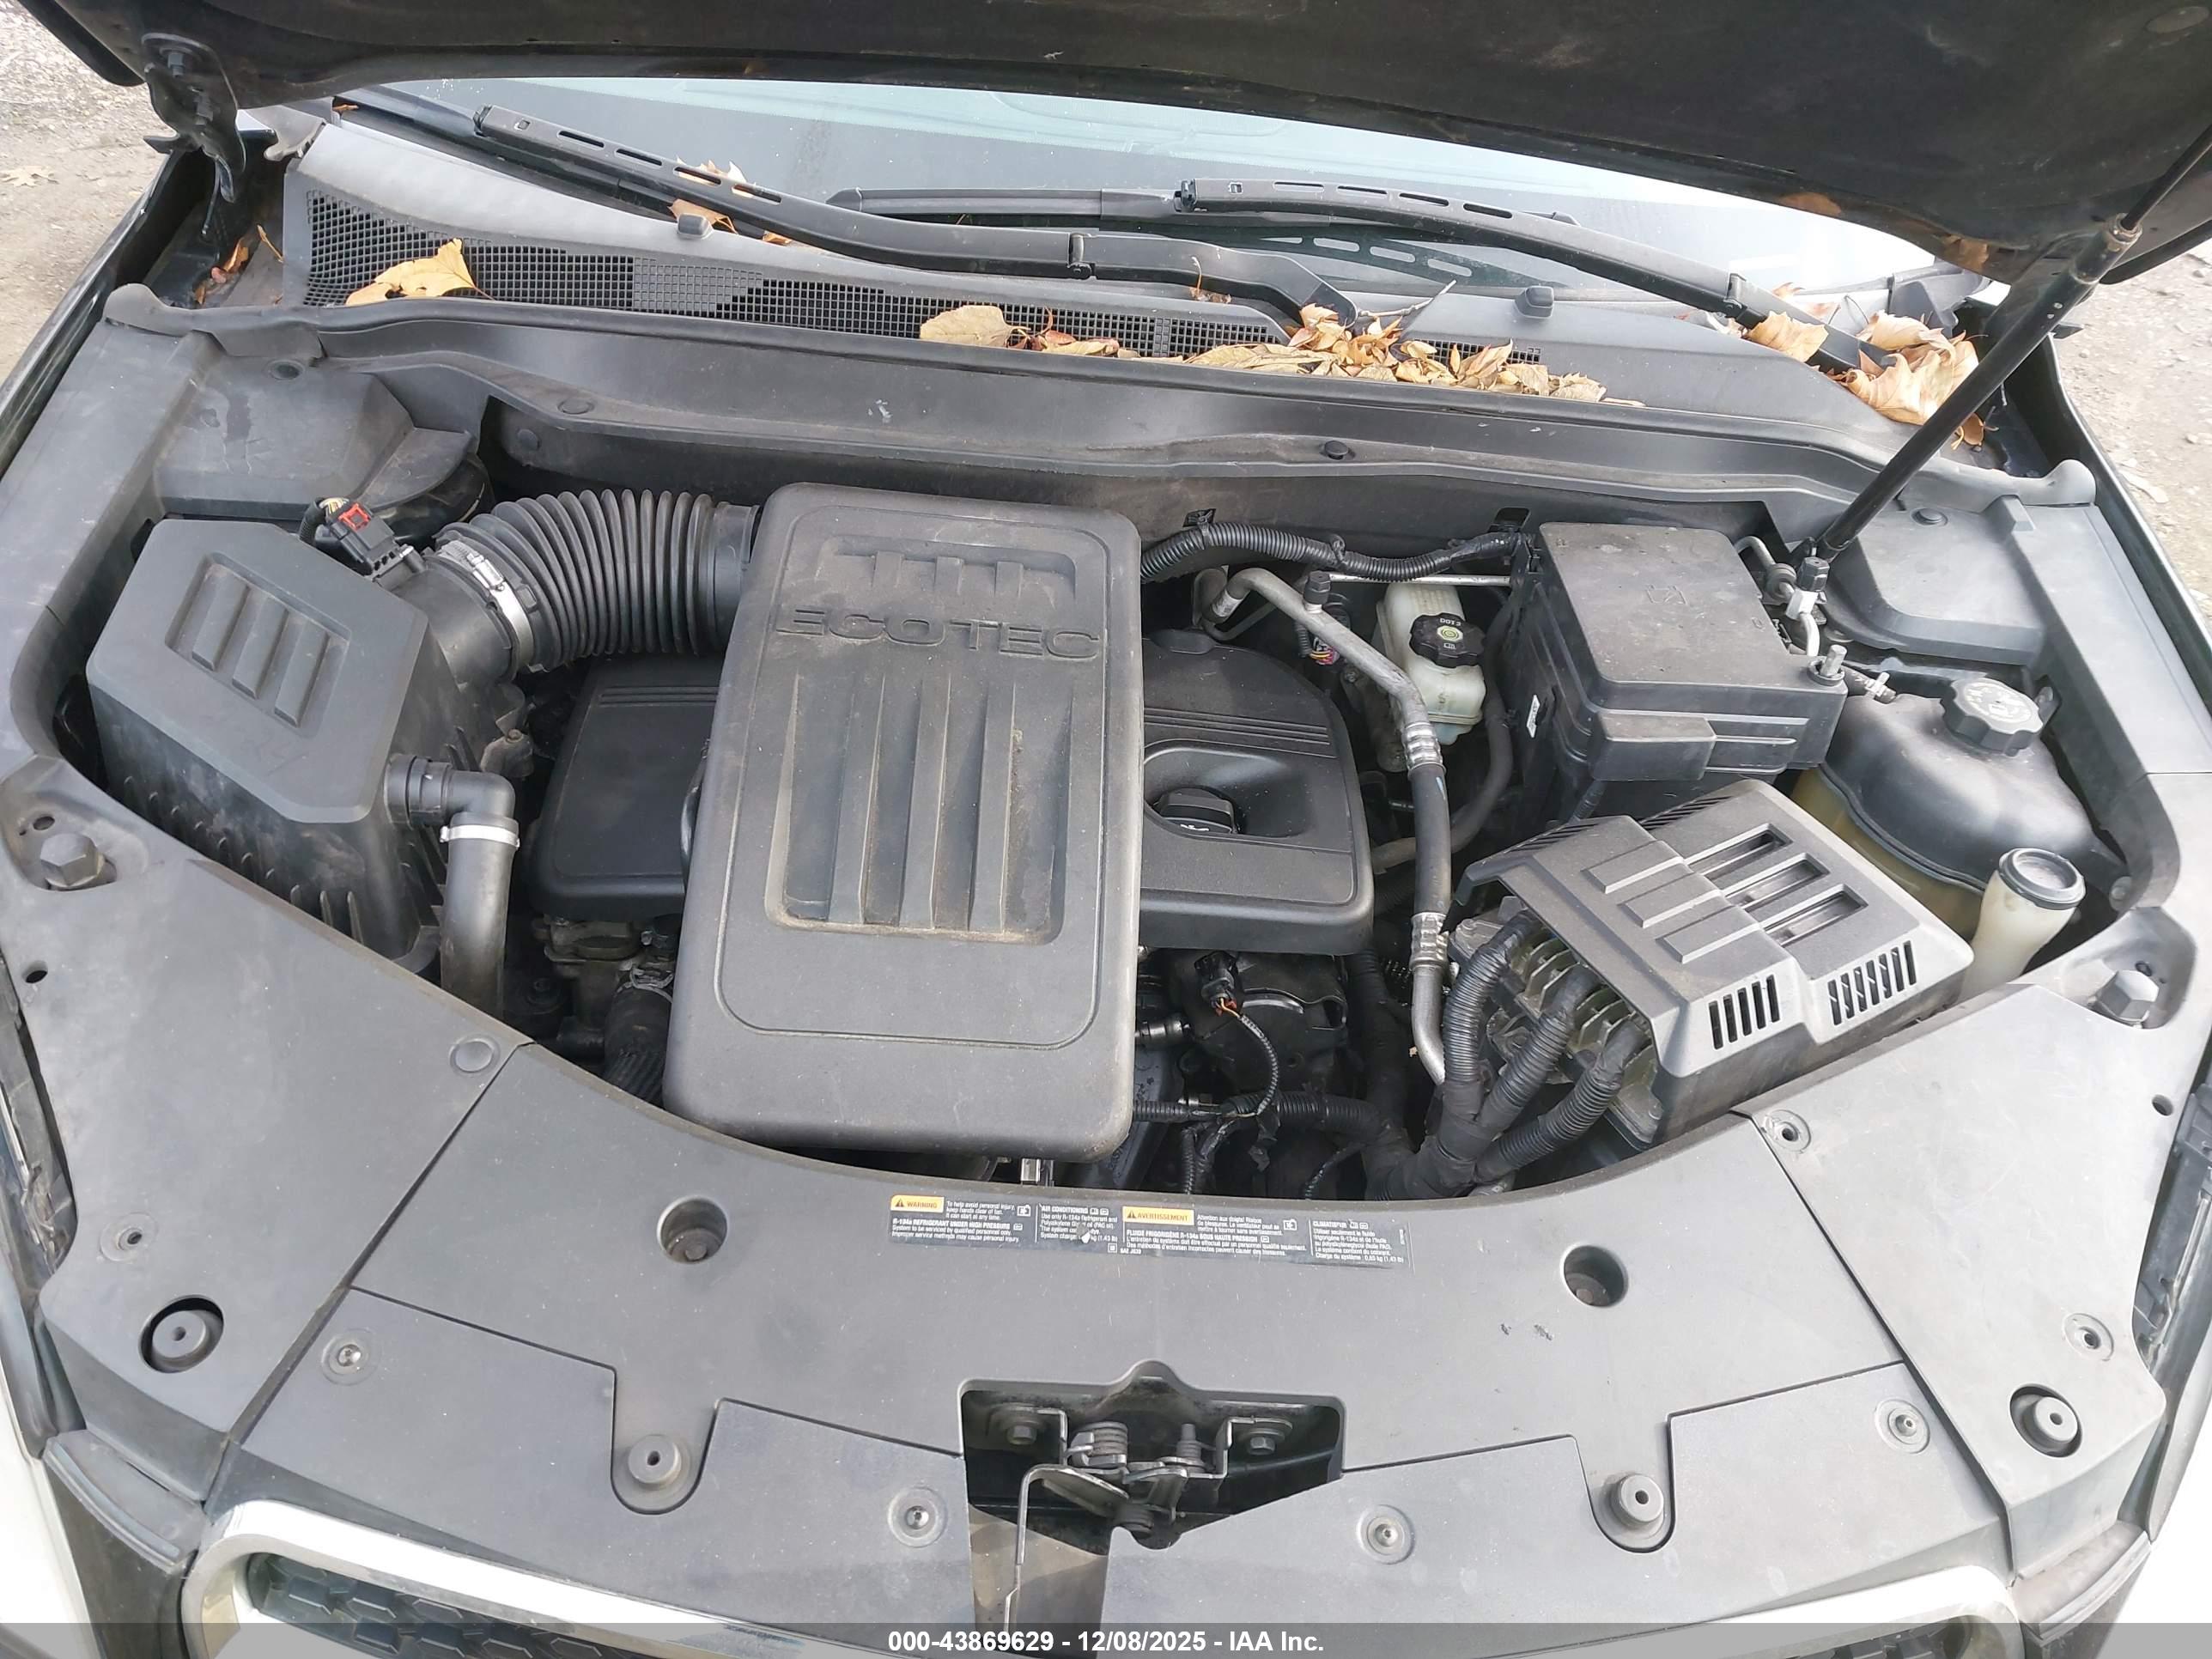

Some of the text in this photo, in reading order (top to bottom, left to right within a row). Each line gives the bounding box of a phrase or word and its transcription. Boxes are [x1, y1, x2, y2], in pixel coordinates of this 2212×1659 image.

[775, 608, 1099, 661] ECOTEC
[1052, 1206, 1088, 1214] CONDITIONING
[1138, 1212, 1188, 1221] AVERTISSEMENT
